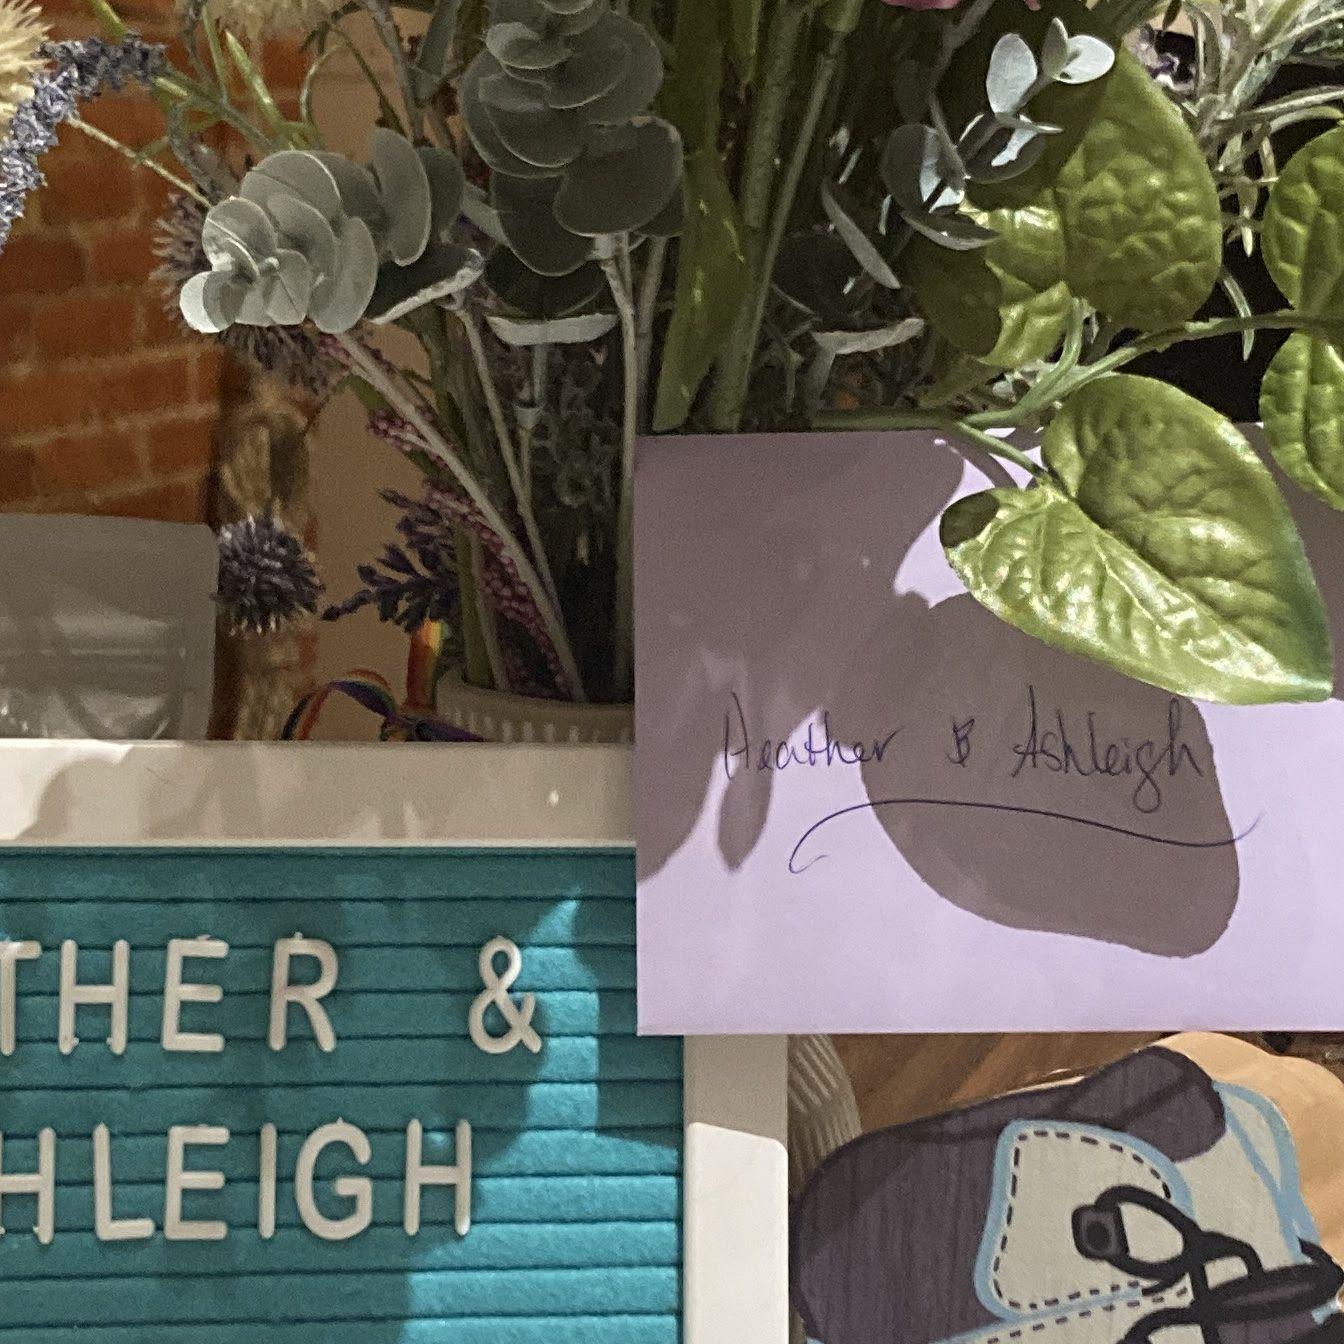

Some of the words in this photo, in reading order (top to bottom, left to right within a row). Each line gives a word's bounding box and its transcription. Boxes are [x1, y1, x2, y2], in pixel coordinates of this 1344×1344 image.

[722, 691, 898, 781] Heather
[1011, 684, 1204, 814] Ashleigh
[467, 936, 542, 1055] &
